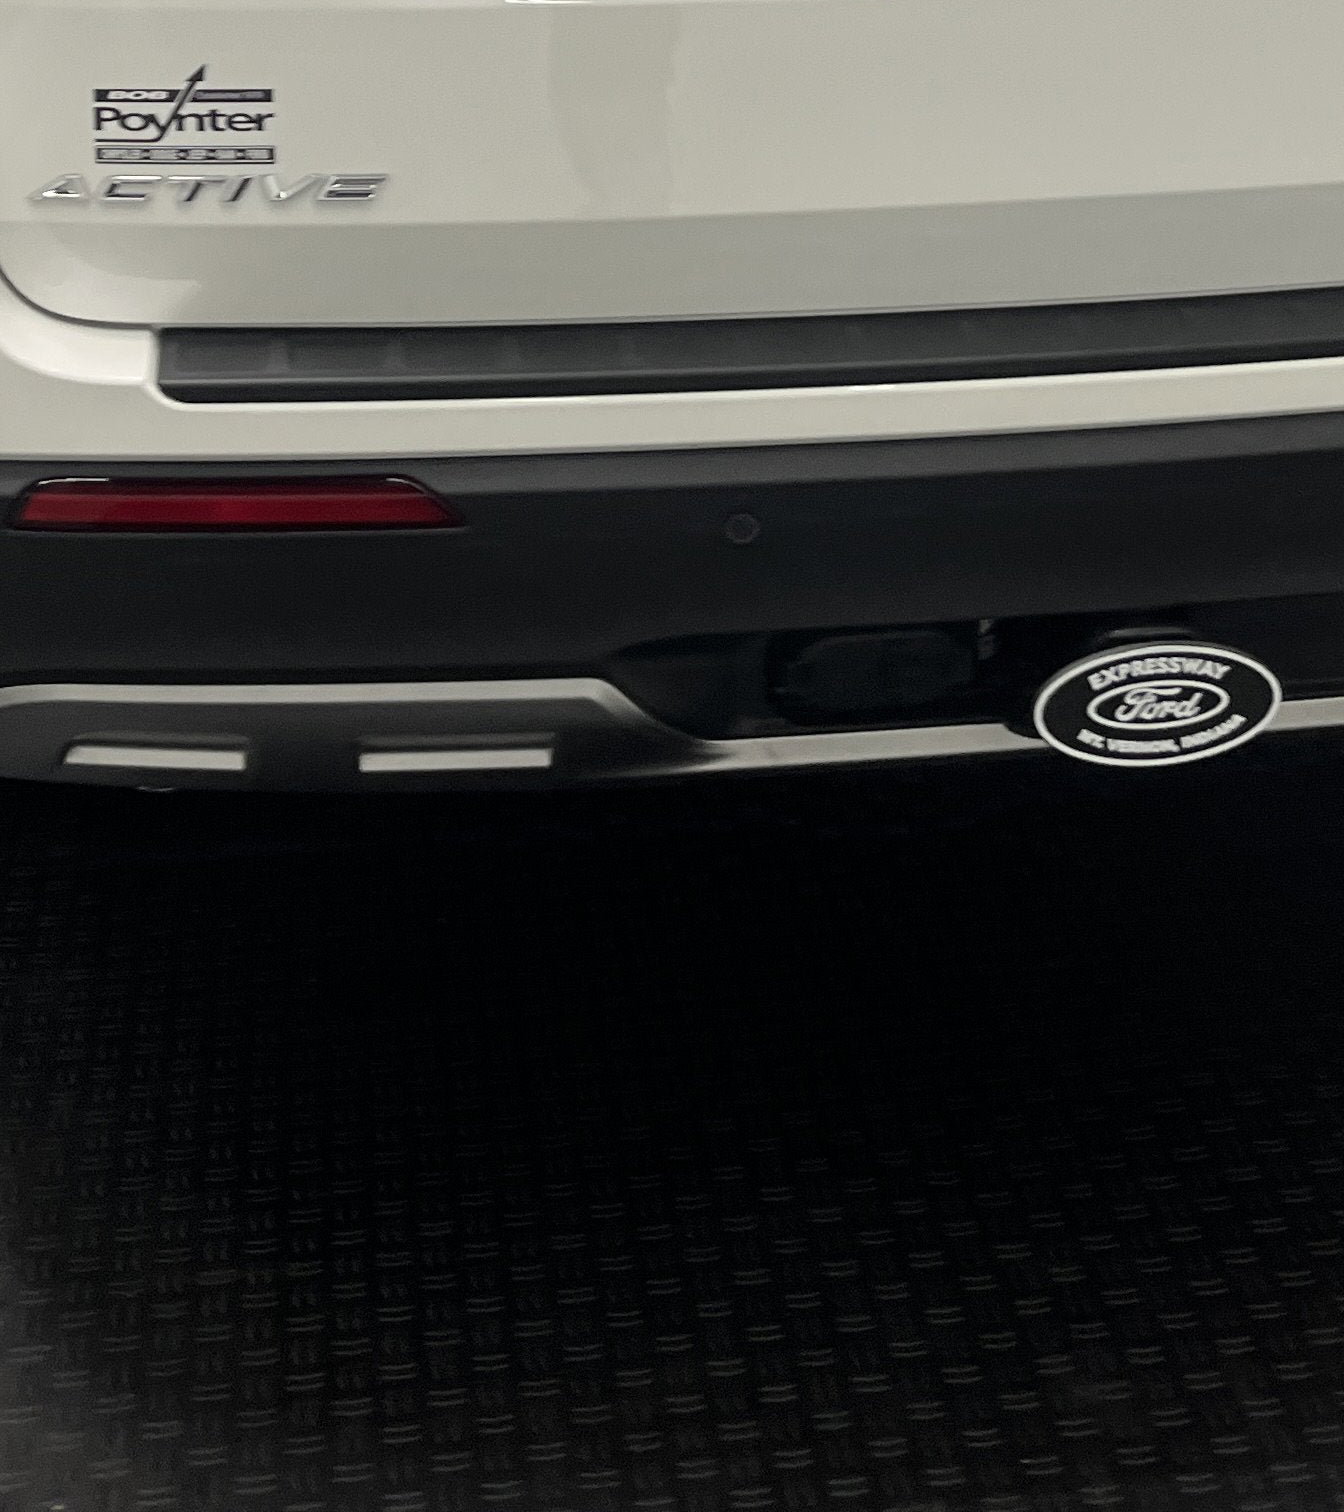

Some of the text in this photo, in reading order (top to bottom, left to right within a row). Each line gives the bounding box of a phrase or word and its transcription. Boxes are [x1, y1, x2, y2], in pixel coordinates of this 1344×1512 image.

[92, 106, 275, 142] Poynter
[28, 173, 389, 202] ACTIVE
[1087, 657, 1232, 689] EXPRESSWAY
[1114, 687, 1203, 721] Ford
